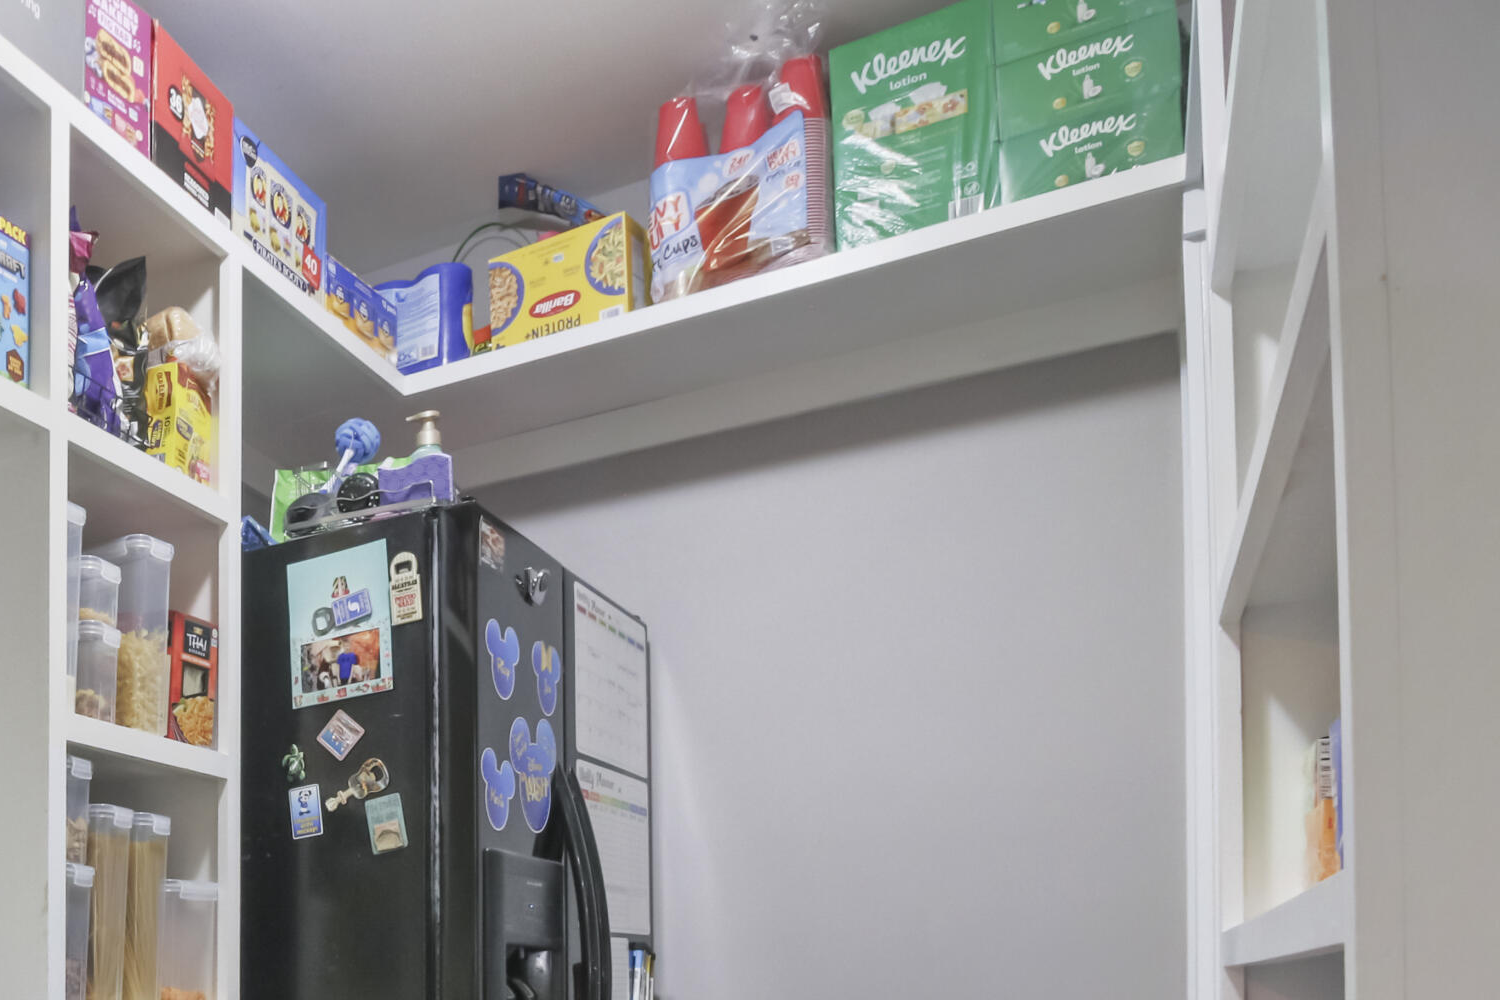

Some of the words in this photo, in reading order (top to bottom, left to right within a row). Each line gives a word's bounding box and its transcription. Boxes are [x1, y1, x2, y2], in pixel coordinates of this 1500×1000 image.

[851, 36, 966, 94] Kleenex
[1037, 34, 1134, 81] Kleenex
[1072, 62, 1101, 77] lotion
[889, 71, 927, 91] lotion
[169, 87, 183, 113] 36
[1039, 113, 1136, 157] Kleenex
[1074, 140, 1103, 154] lotion
[0, 216, 27, 245] PACK
[664, 235, 699, 260] Cups
[305, 254, 318, 275] 40
[533, 293, 575, 314] Barilla
[525, 314, 581, 340] PROTEIN+
[186, 633, 207, 651] THAI
